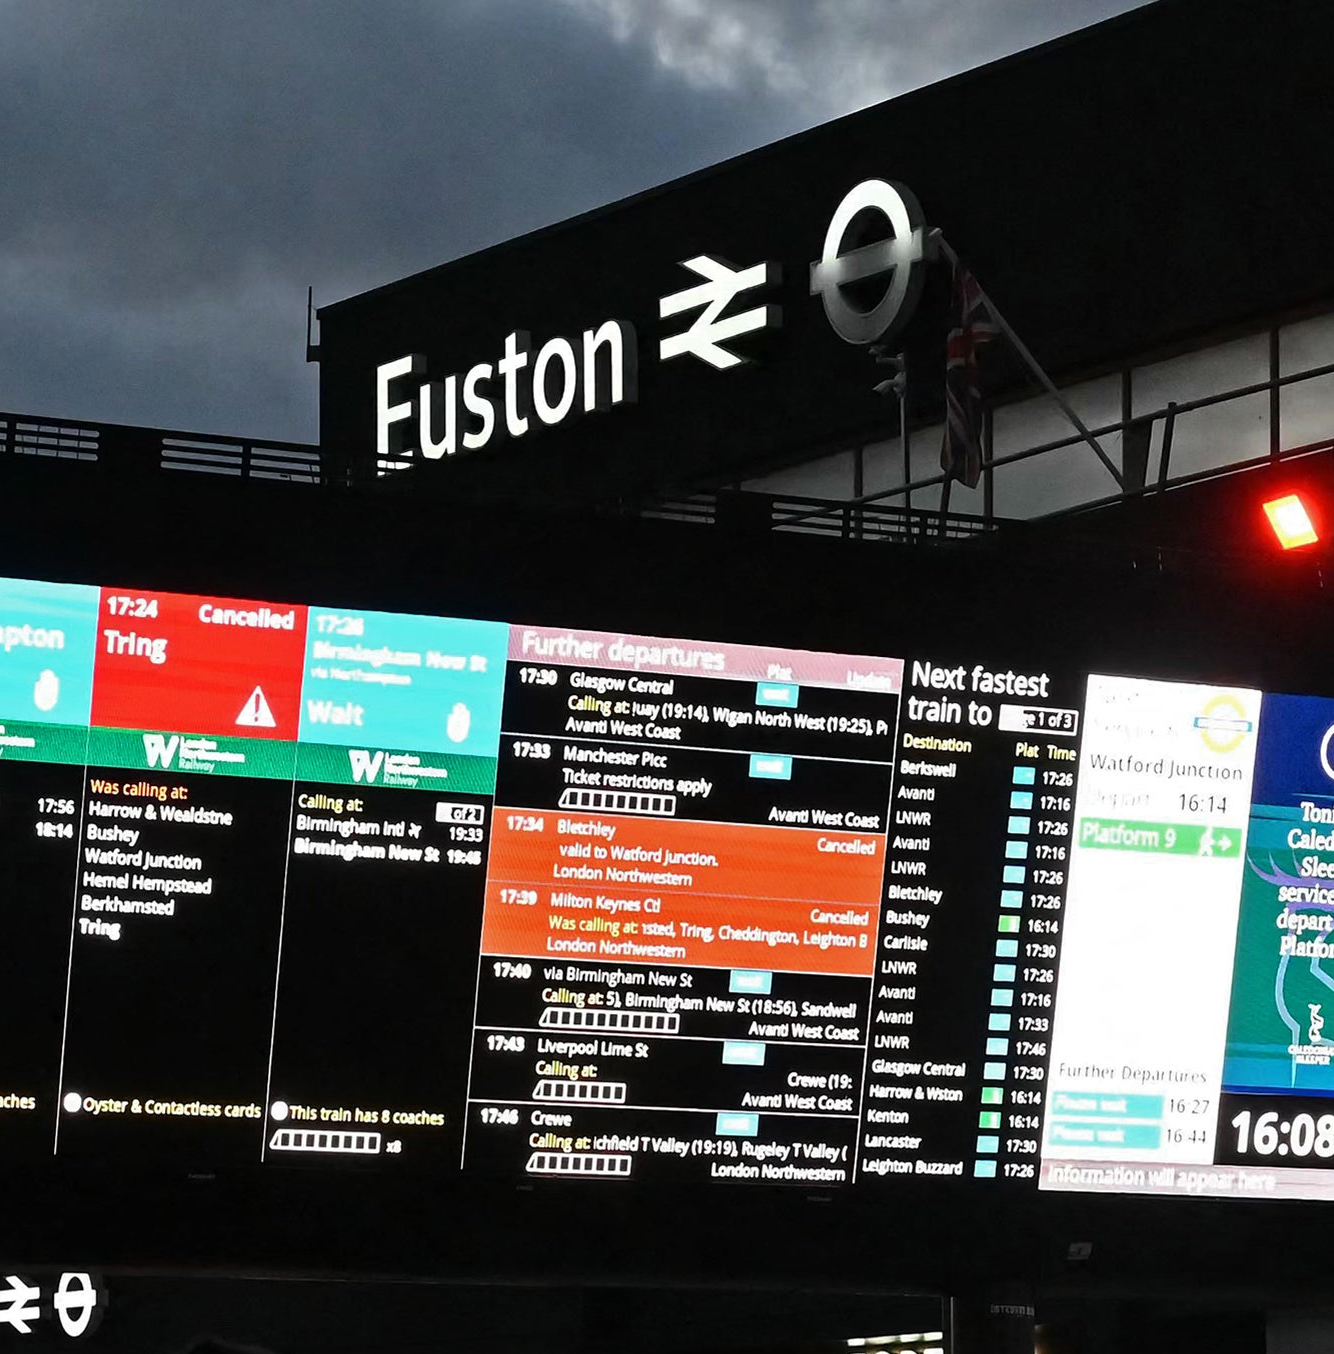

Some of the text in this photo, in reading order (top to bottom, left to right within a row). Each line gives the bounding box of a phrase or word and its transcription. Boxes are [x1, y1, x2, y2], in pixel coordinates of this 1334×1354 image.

[376, 318, 623, 476] Euston
[107, 596, 294, 630] 17:24 Cancelled
[104, 630, 168, 665] Tring
[522, 631, 725, 671] Further departures
[570, 672, 674, 696] Glasgow Central
[912, 661, 967, 692] Next
[972, 666, 1050, 697] fastest
[307, 699, 364, 726] Wait
[908, 696, 992, 726] train to
[564, 745, 667, 768] Manchester Picc
[903, 734, 1077, 761] Destination Plat Time
[1090, 754, 1243, 782] Watford Junction
[91, 779, 188, 801] Was calling at:
[37, 798, 75, 815] 17:56
[89, 801, 233, 826] Harrow & Wealdstne
[299, 795, 364, 813] Calling at:
[1179, 795, 1227, 814] 16:14
[87, 824, 140, 846] Bushey
[817, 838, 876, 855] Cancelled
[1082, 821, 1176, 849] Platform 9
[85, 848, 202, 871] Watford Junction
[84, 872, 212, 896] Hemel Hempstead
[81, 895, 175, 916] Berkhamsted
[79, 918, 122, 940] Tring
[886, 911, 1059, 934] Bushey 16:14
[1277, 909, 1333, 934] depart
[544, 966, 692, 988] via Birmingham New St
[538, 1039, 648, 1059] Liverpool Lime St
[83, 1097, 262, 1118] Oyster & Contactless cards
[531, 1111, 572, 1127] Crewe
